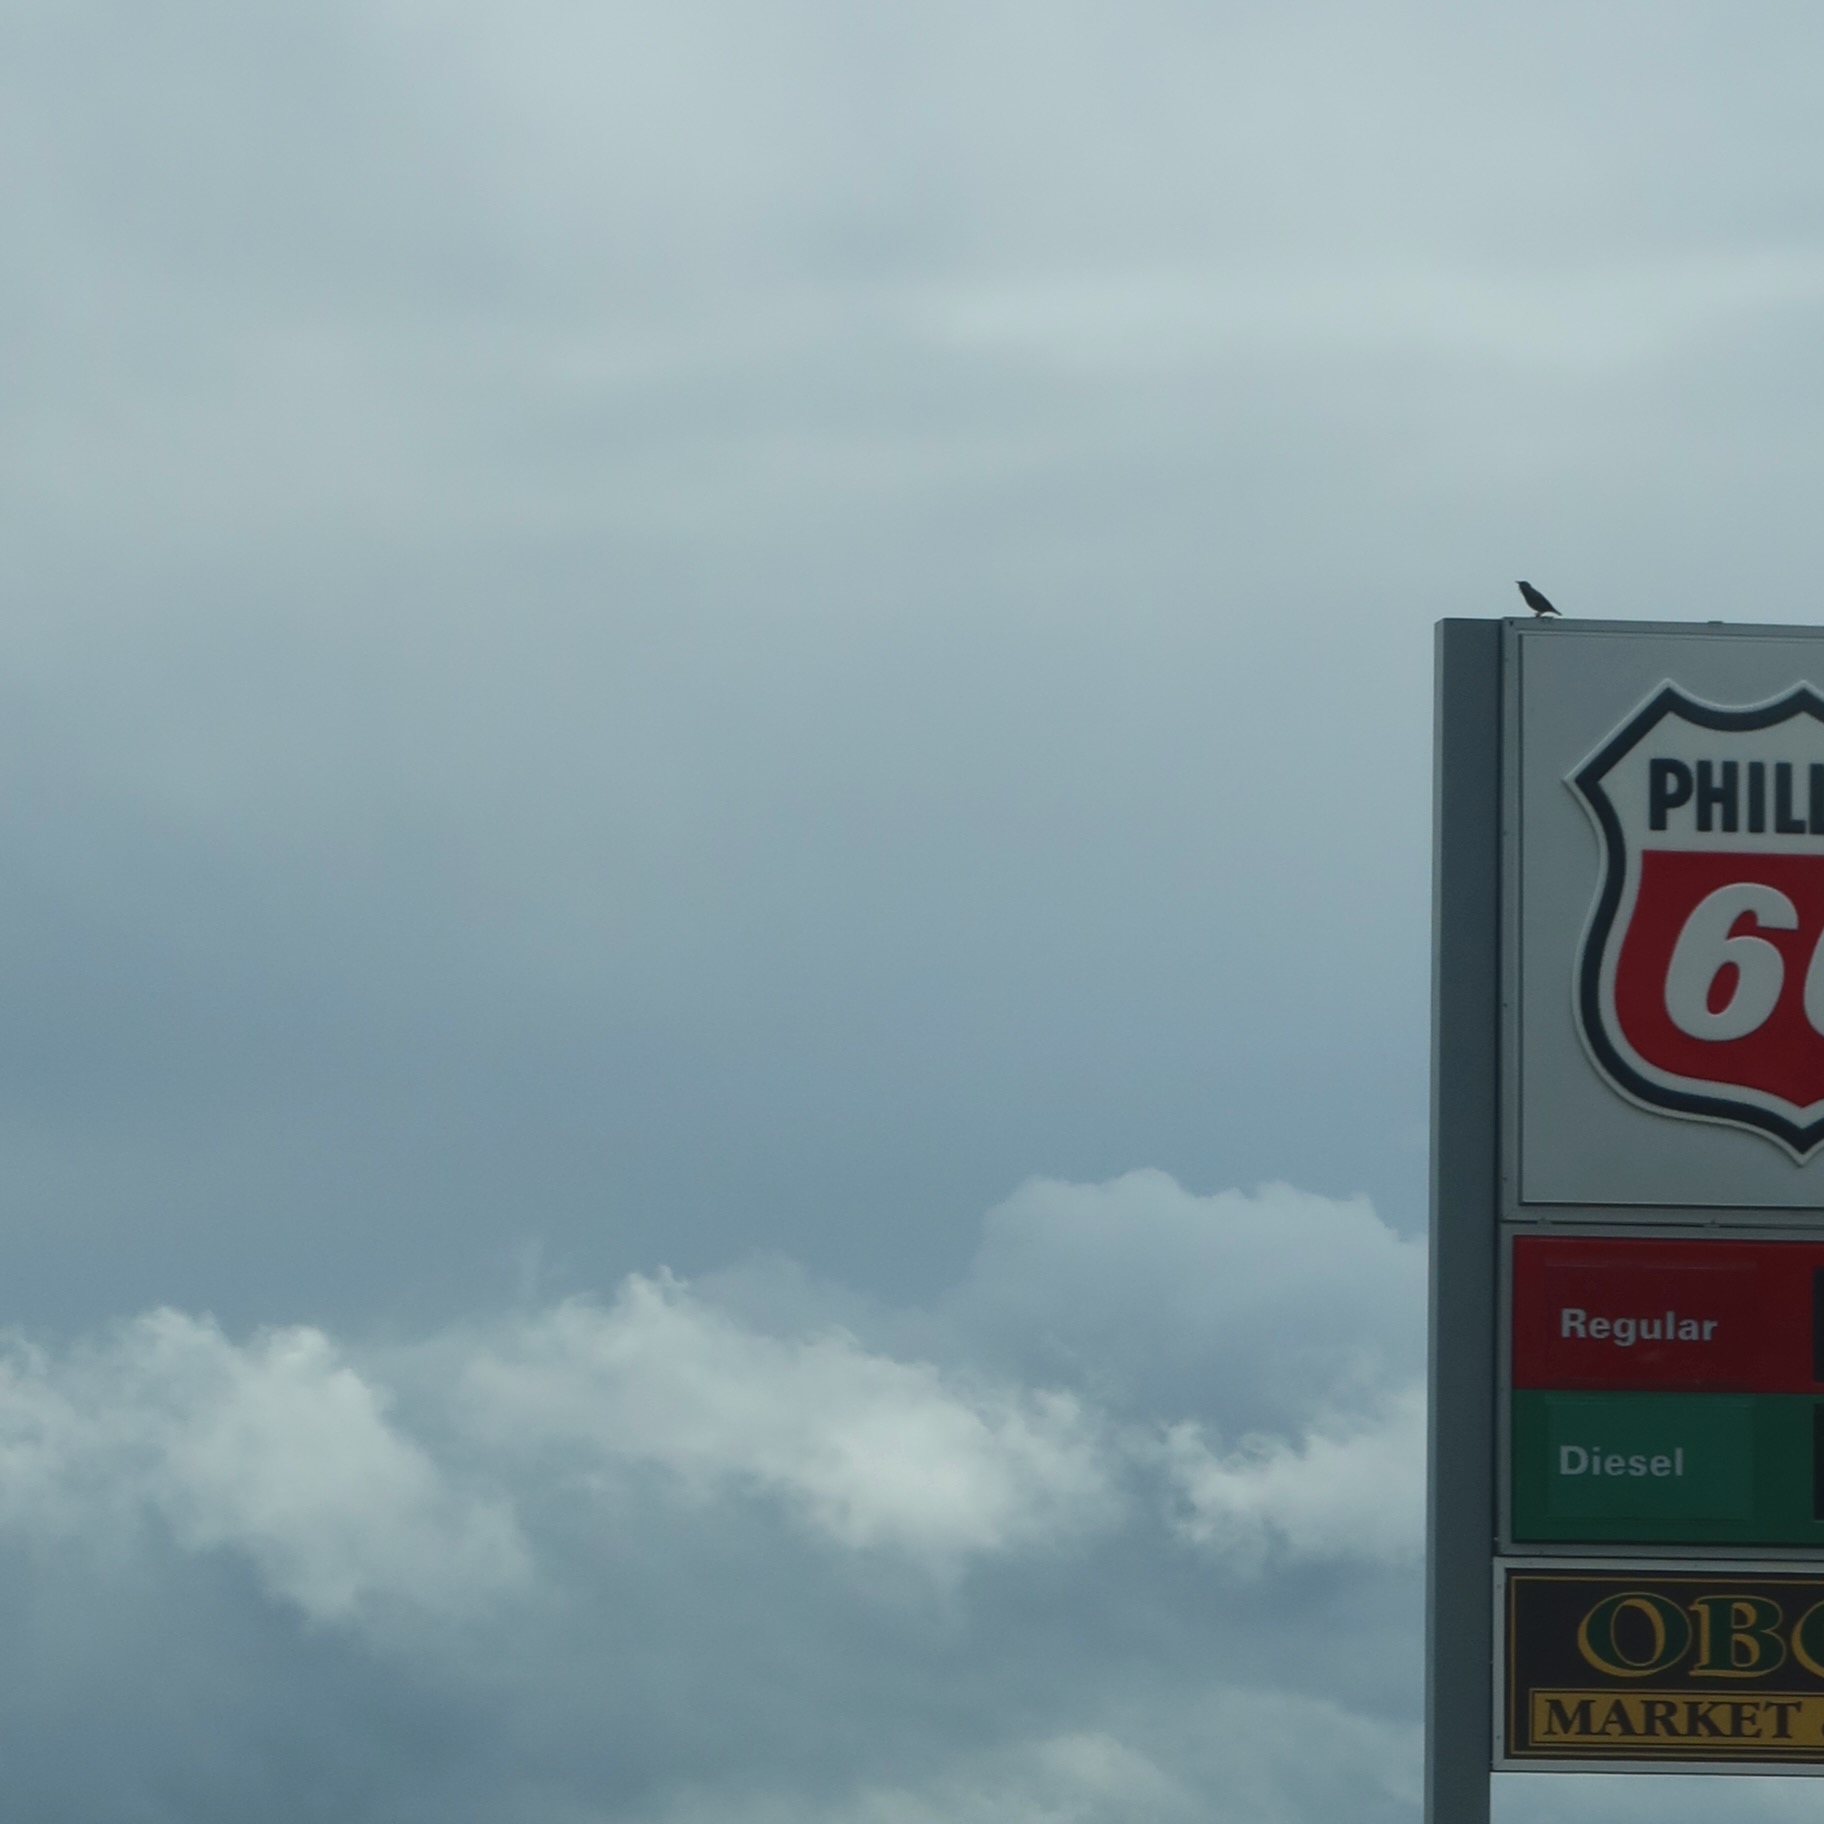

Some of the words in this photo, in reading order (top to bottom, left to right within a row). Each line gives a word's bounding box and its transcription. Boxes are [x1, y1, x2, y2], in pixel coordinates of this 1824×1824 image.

[1560, 1307, 1719, 1347] Regular
[1559, 1444, 1684, 1477] Diesel
[1543, 1698, 1802, 1741] MARKET
